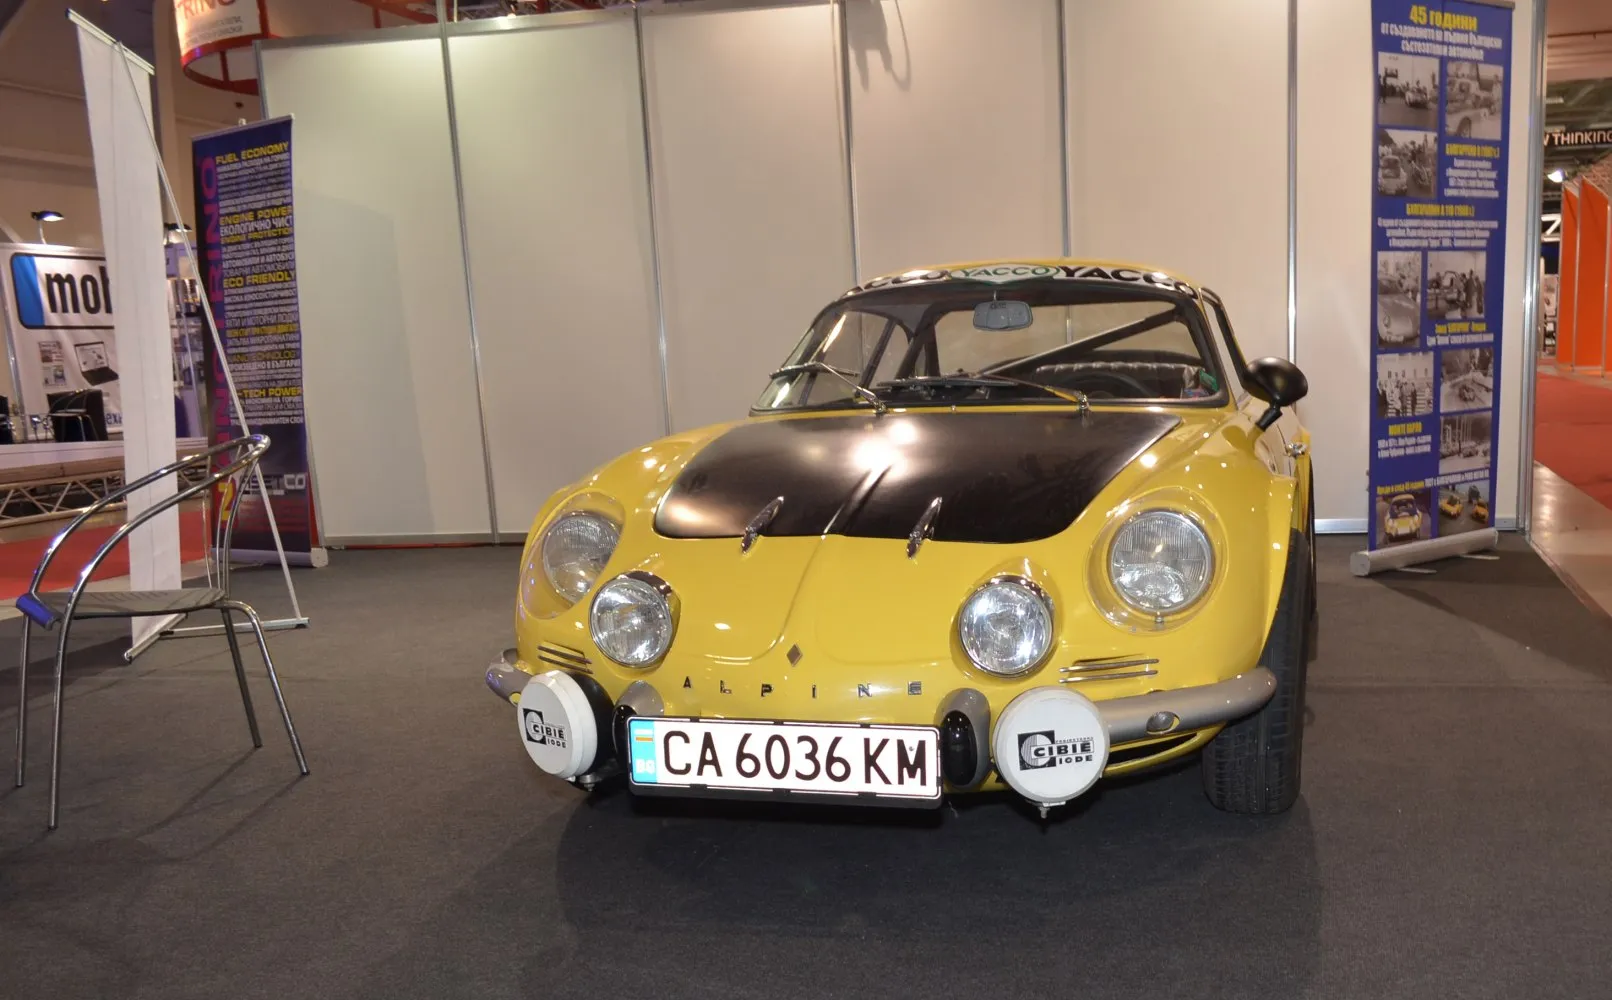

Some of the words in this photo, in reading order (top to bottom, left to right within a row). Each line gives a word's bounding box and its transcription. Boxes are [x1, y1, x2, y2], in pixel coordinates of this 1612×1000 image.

[1409, 5, 1428, 25] 45
[215, 153, 240, 165] FUEL
[241, 142, 289, 160] ECONOMY
[219, 211, 255, 225] ENGINE
[257, 206, 293, 220] POWER
[223, 277, 244, 288] ECO
[246, 270, 296, 285] FRIENDLY
[960, 266, 1051, 277] YACCO
[1058, 265, 1199, 299] YACCO
[268, 387, 303, 397] POWER
[683, 676, 922, 699] ALPINE
[533, 724, 565, 739] CIBIE
[547, 738, 567, 749] IODE
[1034, 742, 1091, 757] CIBIE
[663, 730, 723, 777] CA
[735, 733, 851, 782] 6036
[863, 737, 927, 786] KM
[1059, 755, 1093, 765] IODE
